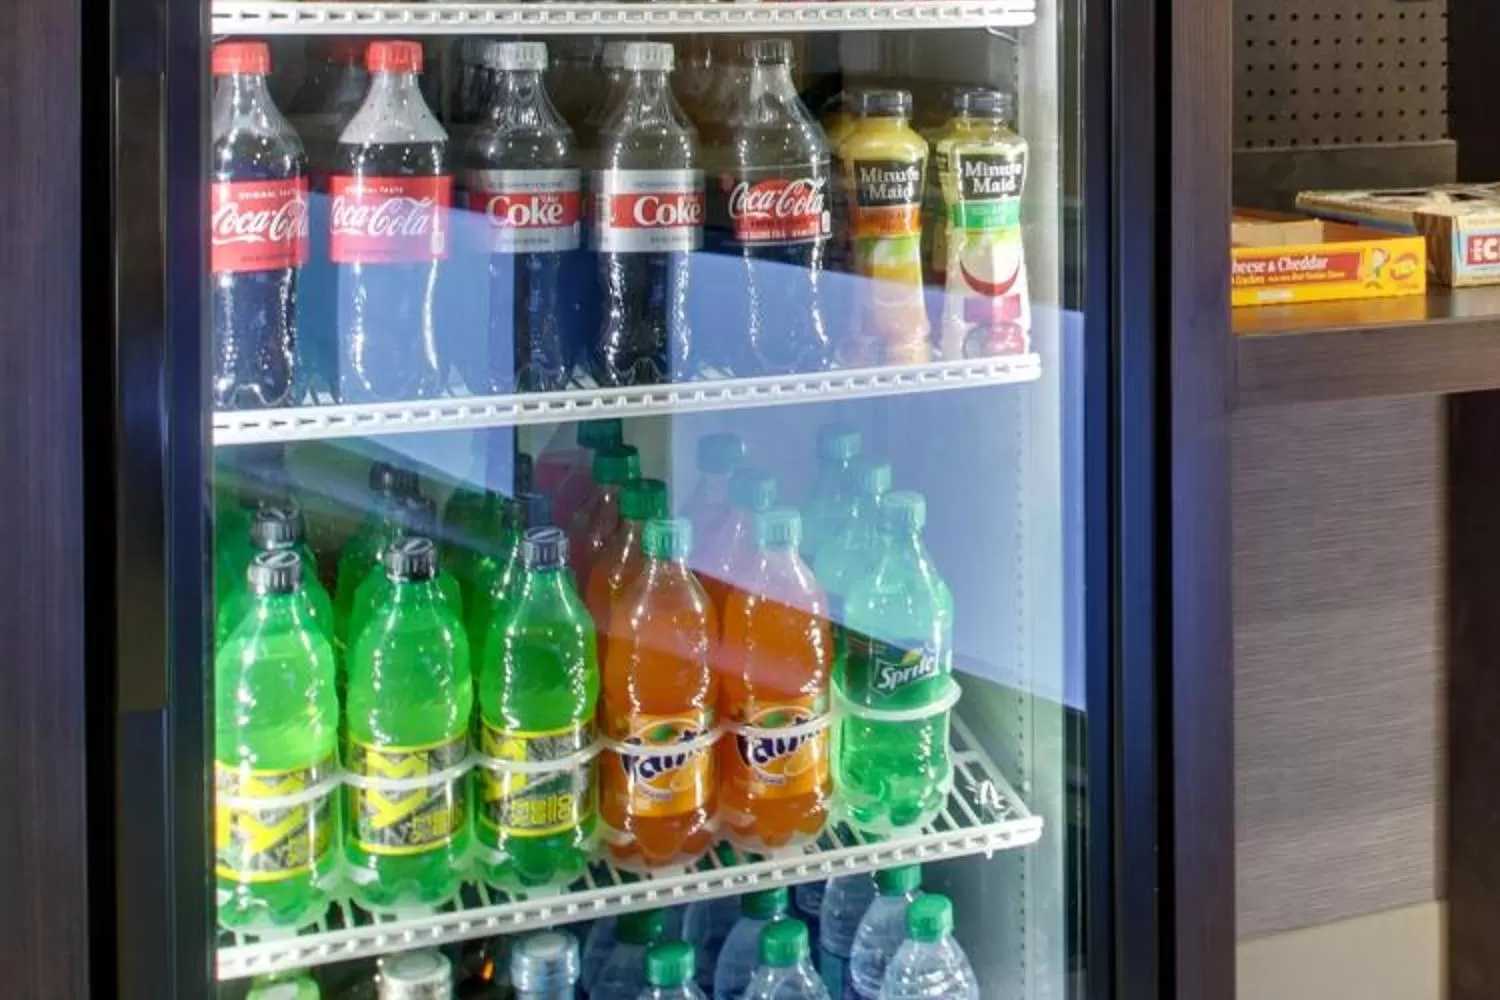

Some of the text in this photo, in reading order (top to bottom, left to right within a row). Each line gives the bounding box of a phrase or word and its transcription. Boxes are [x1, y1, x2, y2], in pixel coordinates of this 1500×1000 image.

[860, 166, 920, 183] Minute
[869, 181, 914, 200] Maid
[973, 176, 1017, 194] Maid
[488, 195, 564, 227] Coke
[633, 195, 701, 227] Coke
[728, 177, 826, 219] Coca-Cola
[878, 653, 936, 691] Sprite
